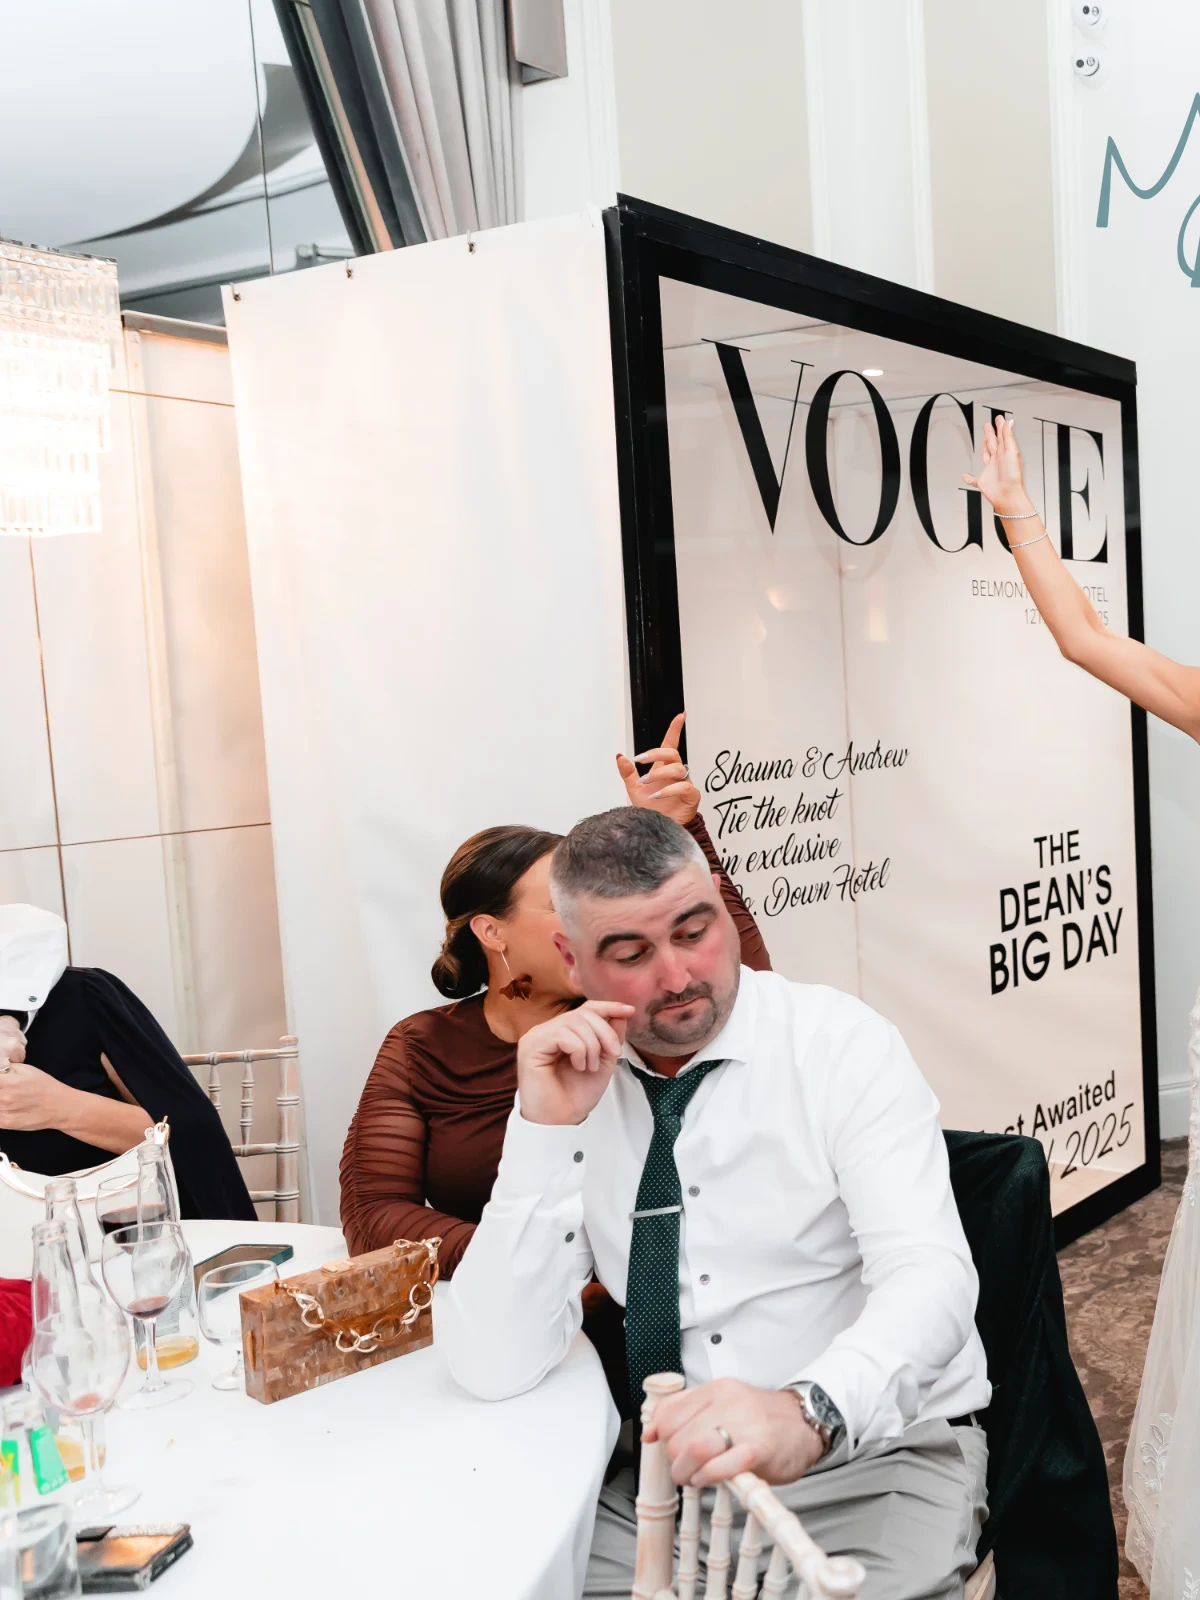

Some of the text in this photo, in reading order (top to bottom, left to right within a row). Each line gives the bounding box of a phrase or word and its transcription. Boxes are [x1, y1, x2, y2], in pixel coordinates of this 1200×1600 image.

[1082, 586, 1109, 602] OTEL
[705, 740, 910, 793] Shauna & Andrew
[713, 788, 844, 839] Tie the knot
[746, 833, 842, 873] exclusive
[1033, 829, 1081, 869] THE
[764, 876, 834, 917] Down
[833, 857, 891, 902] Hotel
[1000, 864, 1112, 933] DEAN'S
[989, 907, 1123, 995] BIG DAY
[1032, 1069, 1115, 1137] Awaited
[1060, 1102, 1134, 1179] 2025
